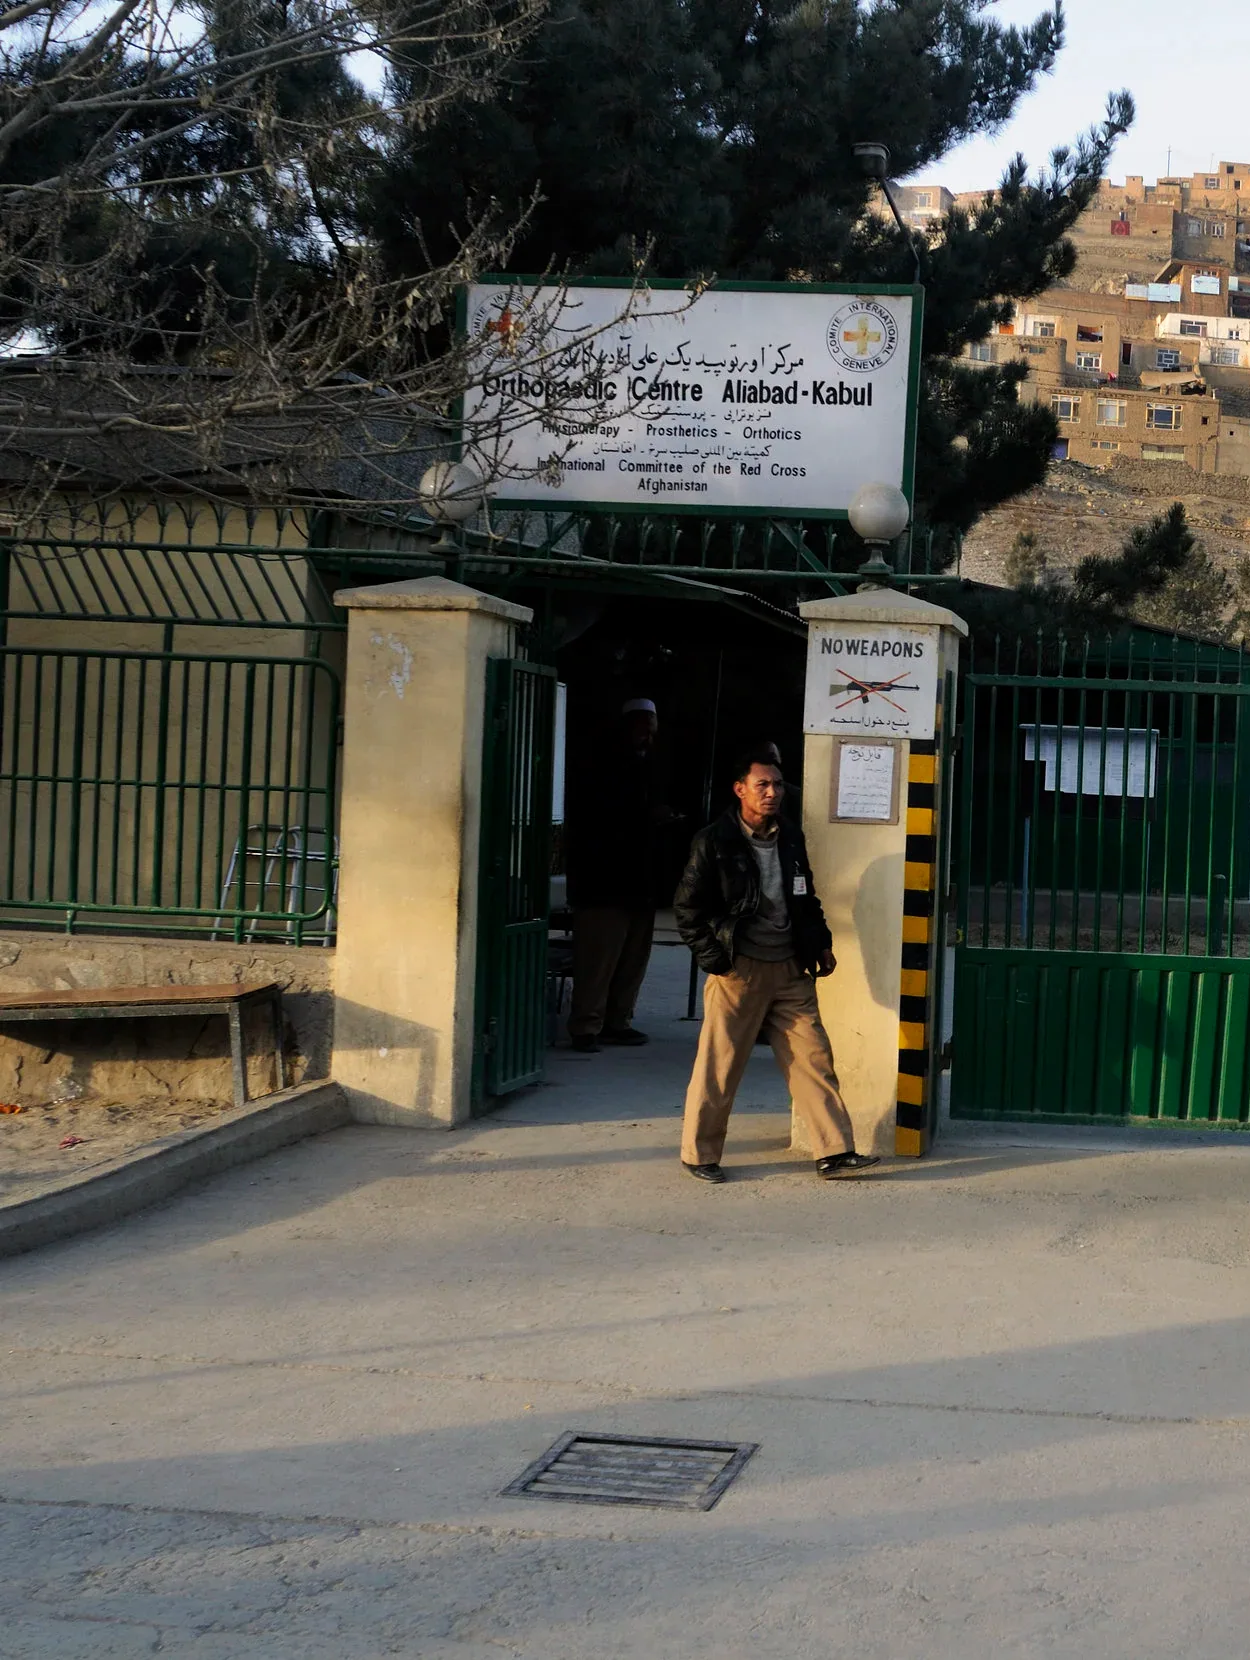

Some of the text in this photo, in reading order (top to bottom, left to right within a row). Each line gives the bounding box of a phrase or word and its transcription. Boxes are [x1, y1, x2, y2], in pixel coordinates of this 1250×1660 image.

[829, 302, 896, 355] COMITE INTERNATIONAL
[842, 357, 884, 370] GENEVE
[632, 376, 704, 403] Centre
[646, 423, 718, 438] Prosthetics
[743, 426, 802, 441] Orthotics
[618, 459, 683, 473] Committee
[692, 460, 706, 474] of
[713, 463, 731, 475] the
[740, 463, 761, 476] Red
[771, 463, 806, 477] Cross
[637, 477, 708, 494] Afghanistan
[821, 637, 924, 658] NO WEAPONS
